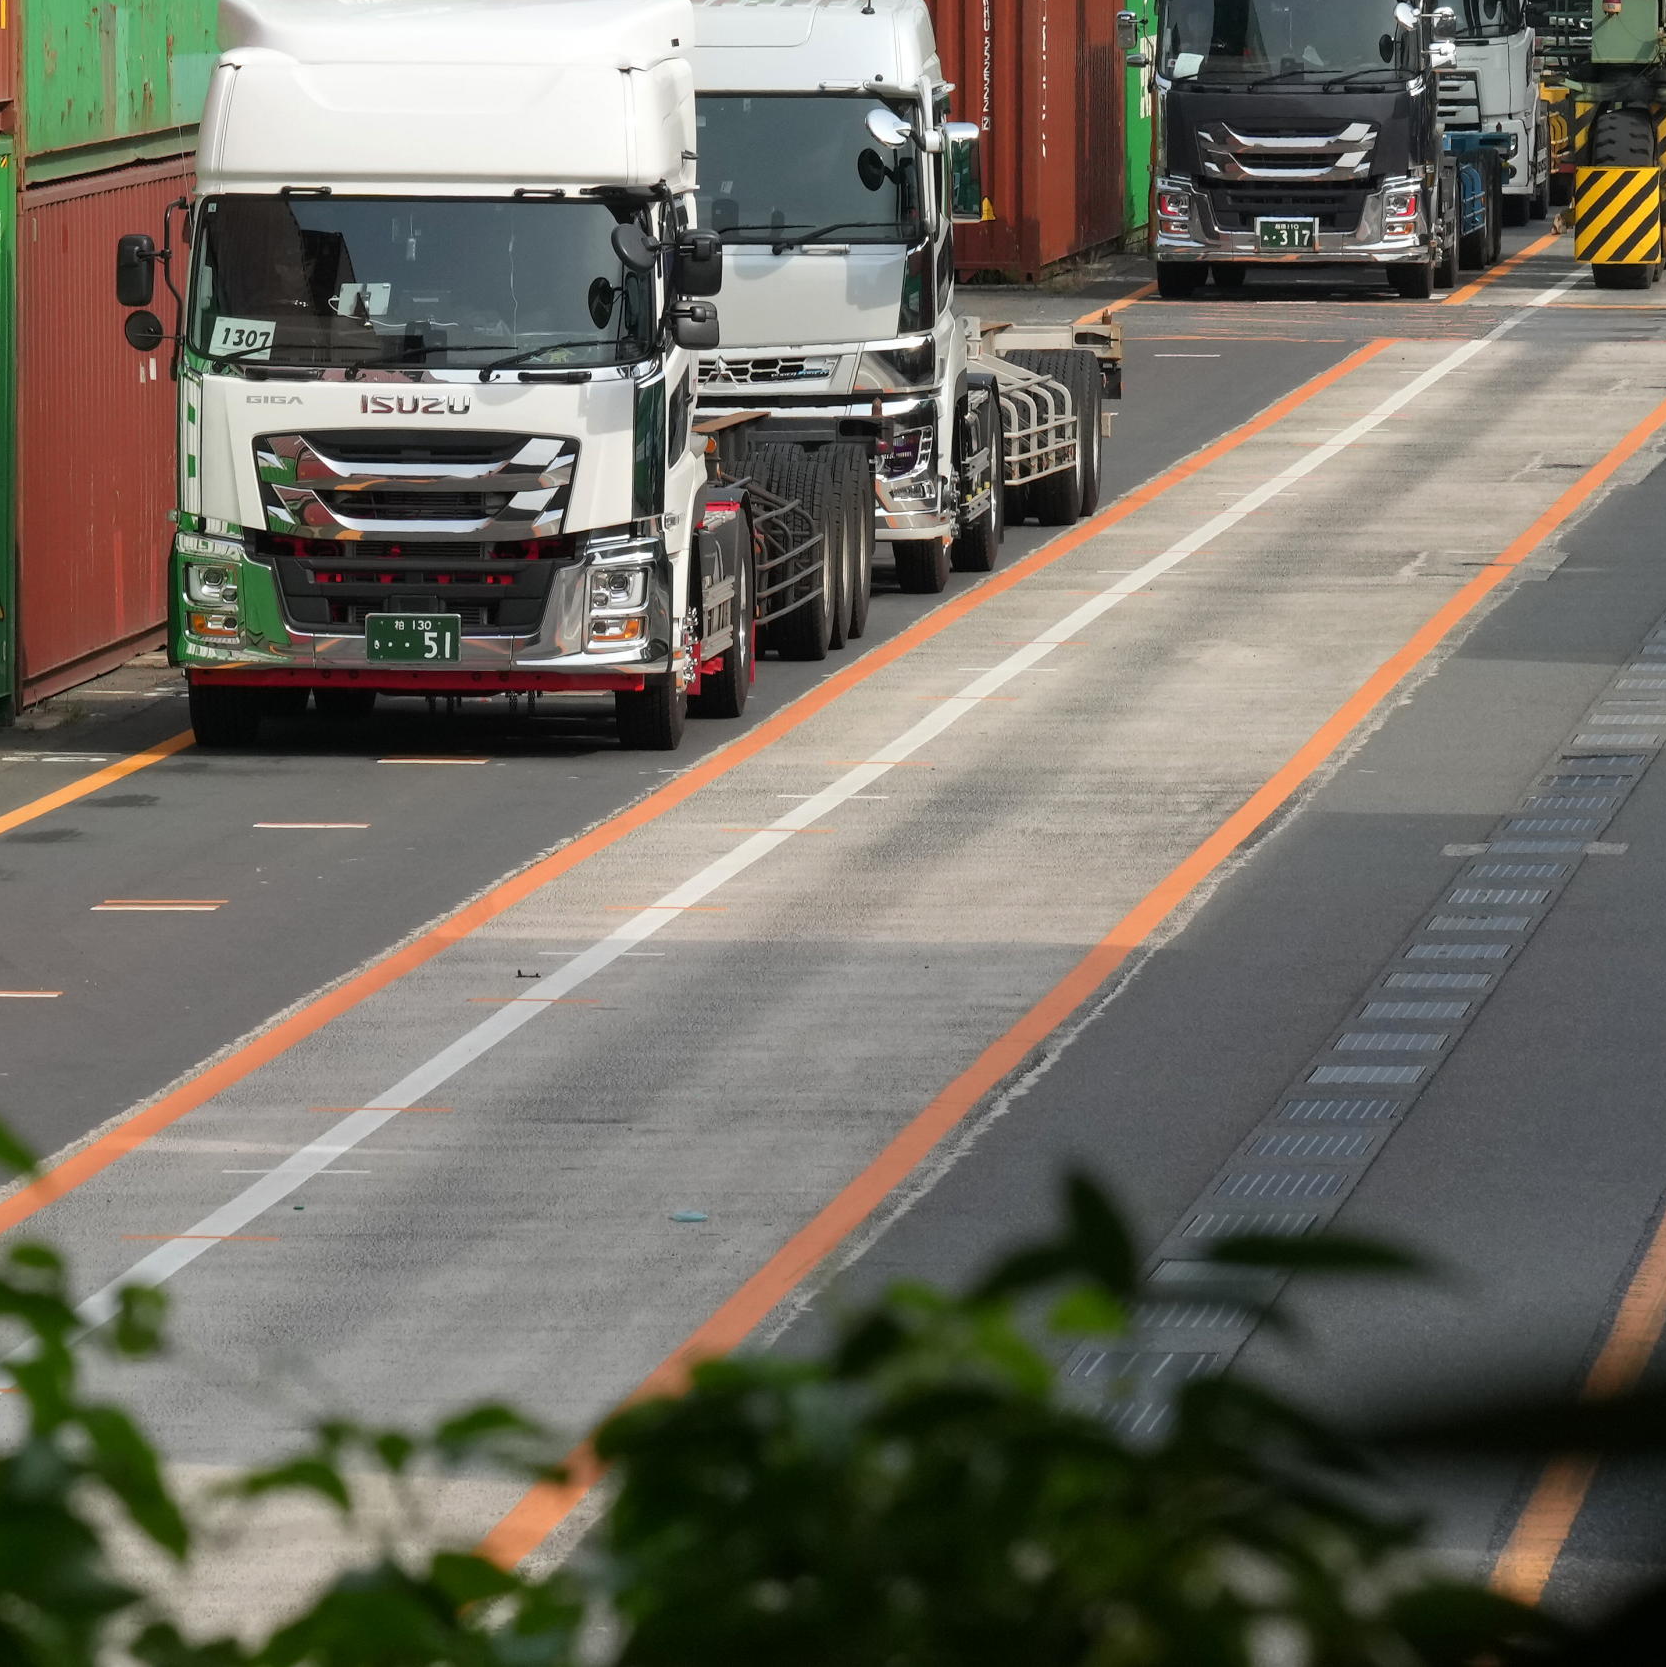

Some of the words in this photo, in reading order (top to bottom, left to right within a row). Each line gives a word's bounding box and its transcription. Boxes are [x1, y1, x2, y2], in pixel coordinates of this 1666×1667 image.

[1279, 229, 1310, 246] 317
[221, 327, 271, 349] 1307
[246, 395, 303, 405] GIGA
[360, 394, 471, 415] ISUZU
[412, 620, 432, 630] 130
[424, 631, 451, 658] 51
